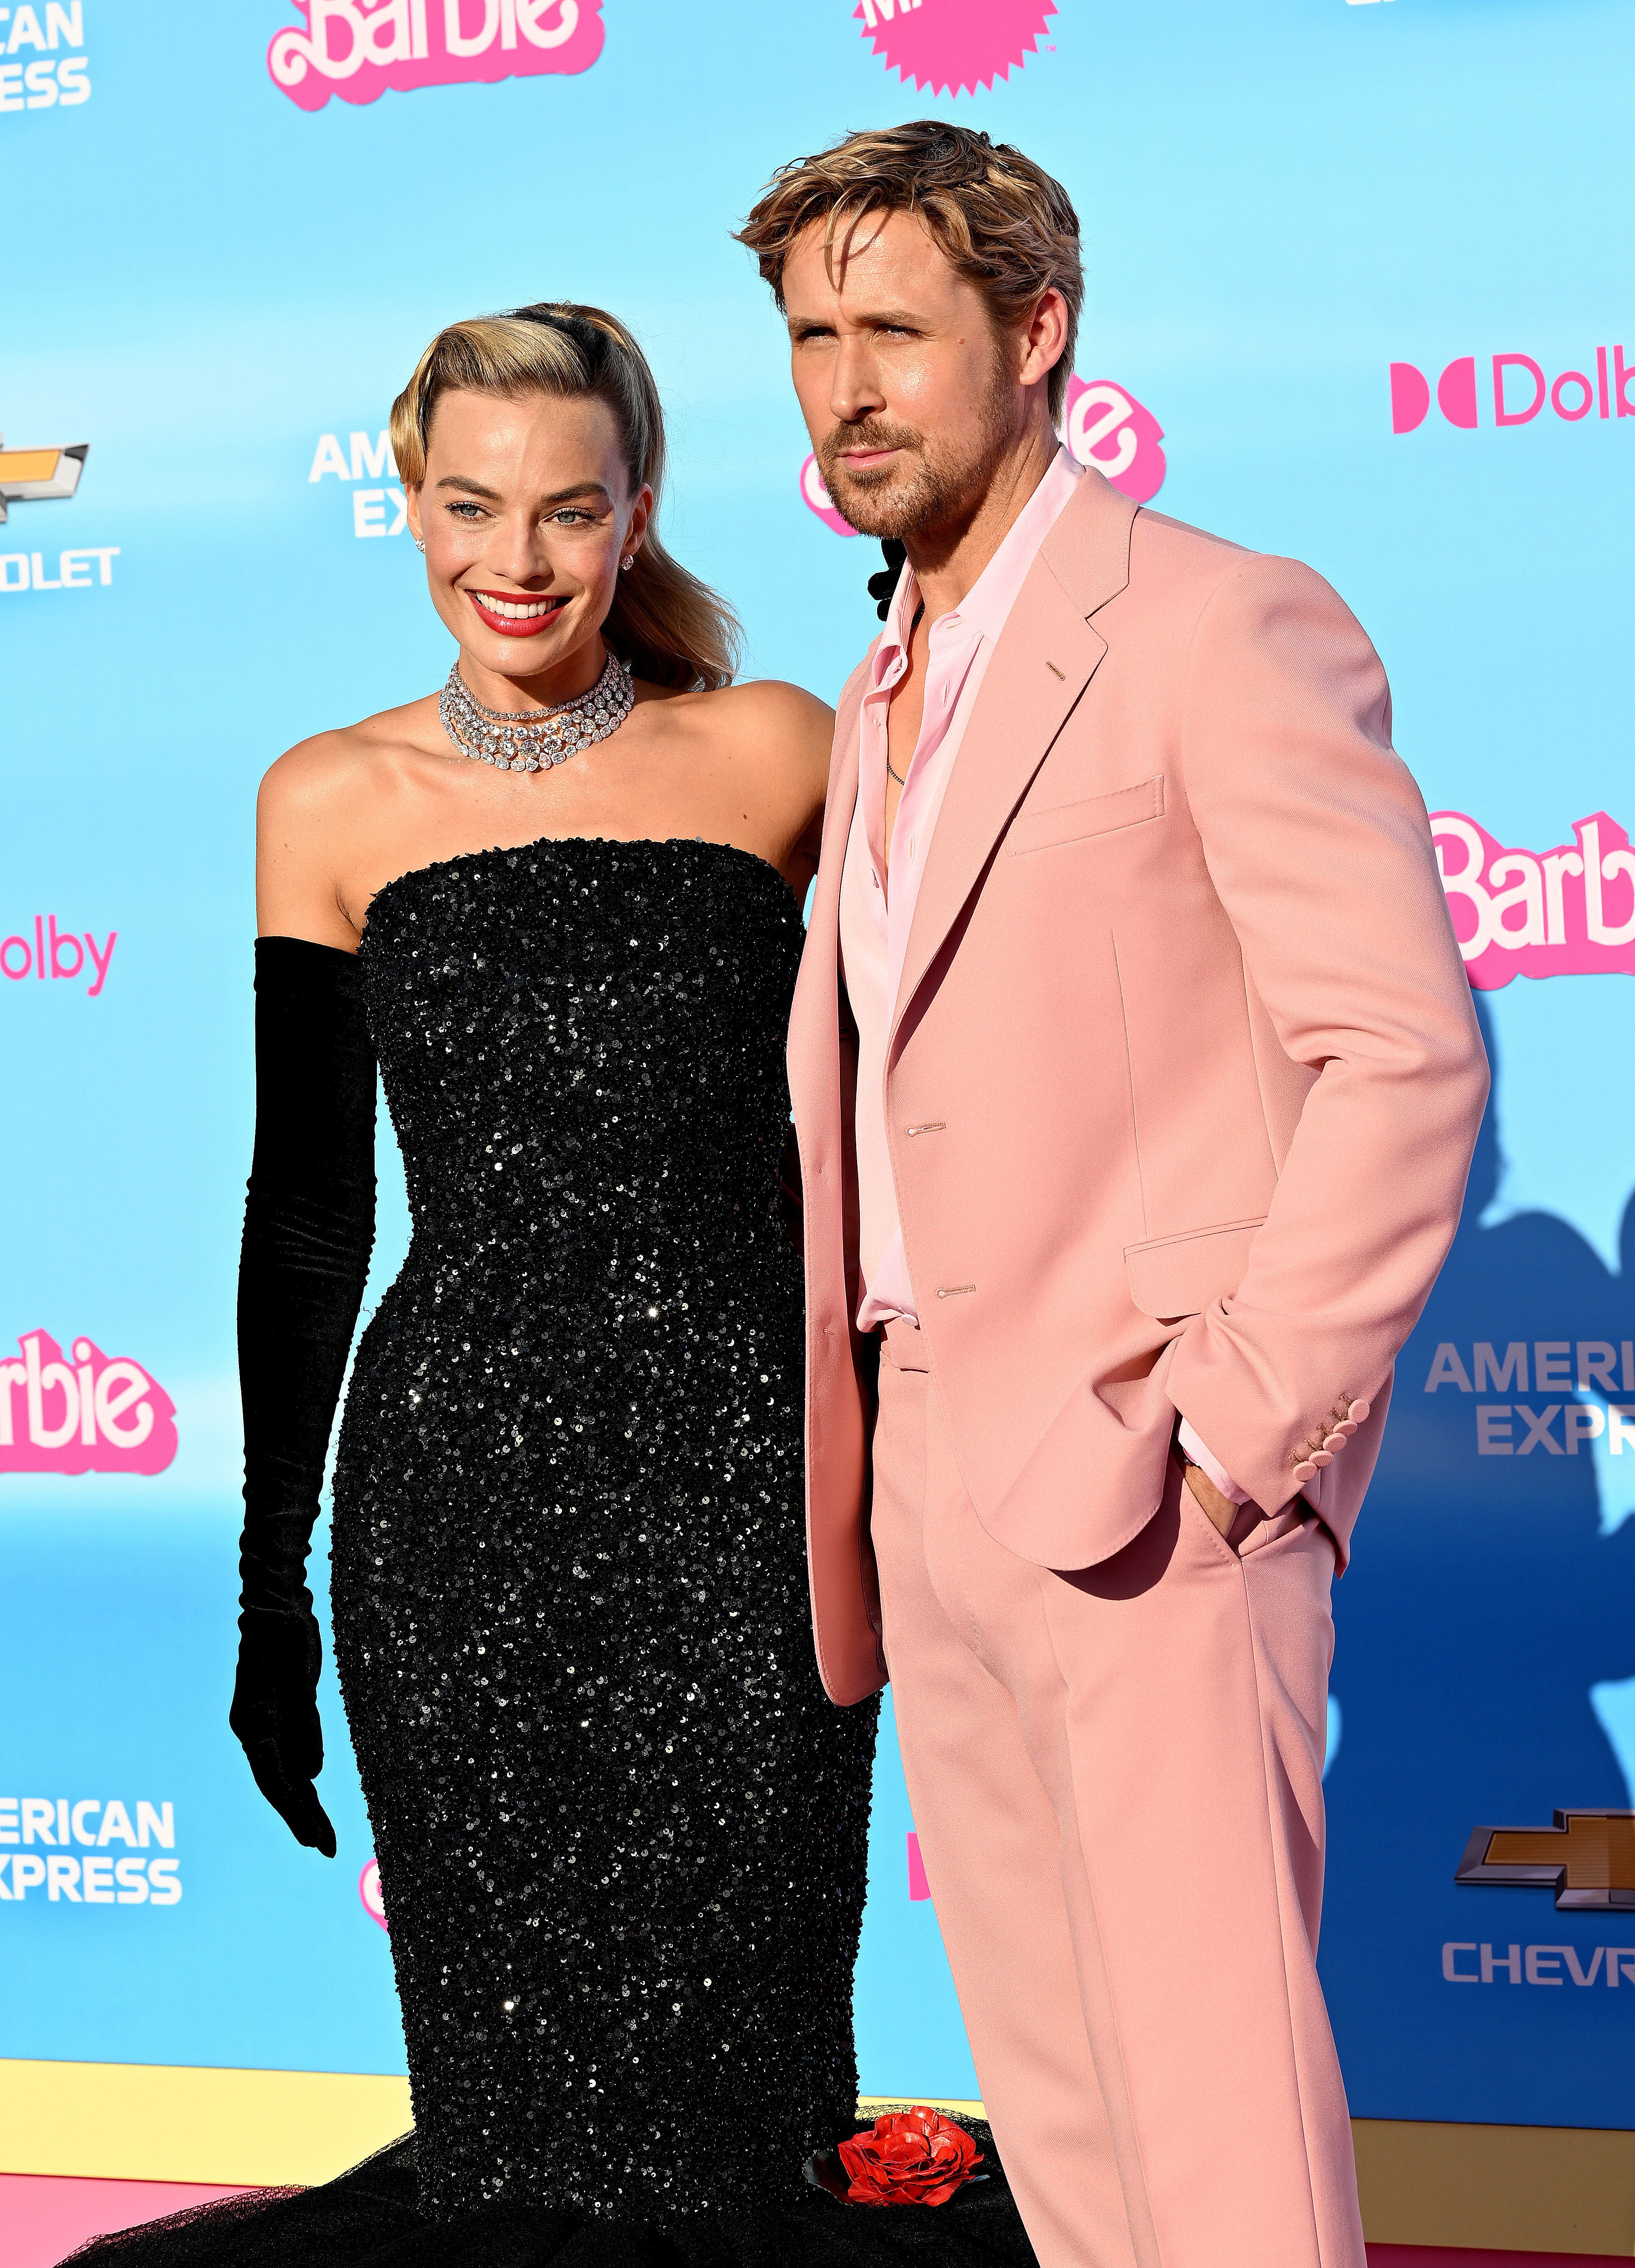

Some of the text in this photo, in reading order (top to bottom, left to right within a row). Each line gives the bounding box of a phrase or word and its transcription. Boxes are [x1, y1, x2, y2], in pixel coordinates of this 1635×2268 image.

[0, 0, 84, 55] AN
[0, 56, 91, 112] ESS
[0, 547, 121, 591] OLET
[1429, 816, 1635, 961] Barb
[0, 913, 118, 997] olby
[0, 1335, 154, 1449] rbie
[1424, 1341, 1635, 1392] AMERI
[1476, 1404, 1635, 1455] EXPR
[0, 1797, 175, 1849] ERICAN
[1442, 1942, 1635, 1987] CHEVR
